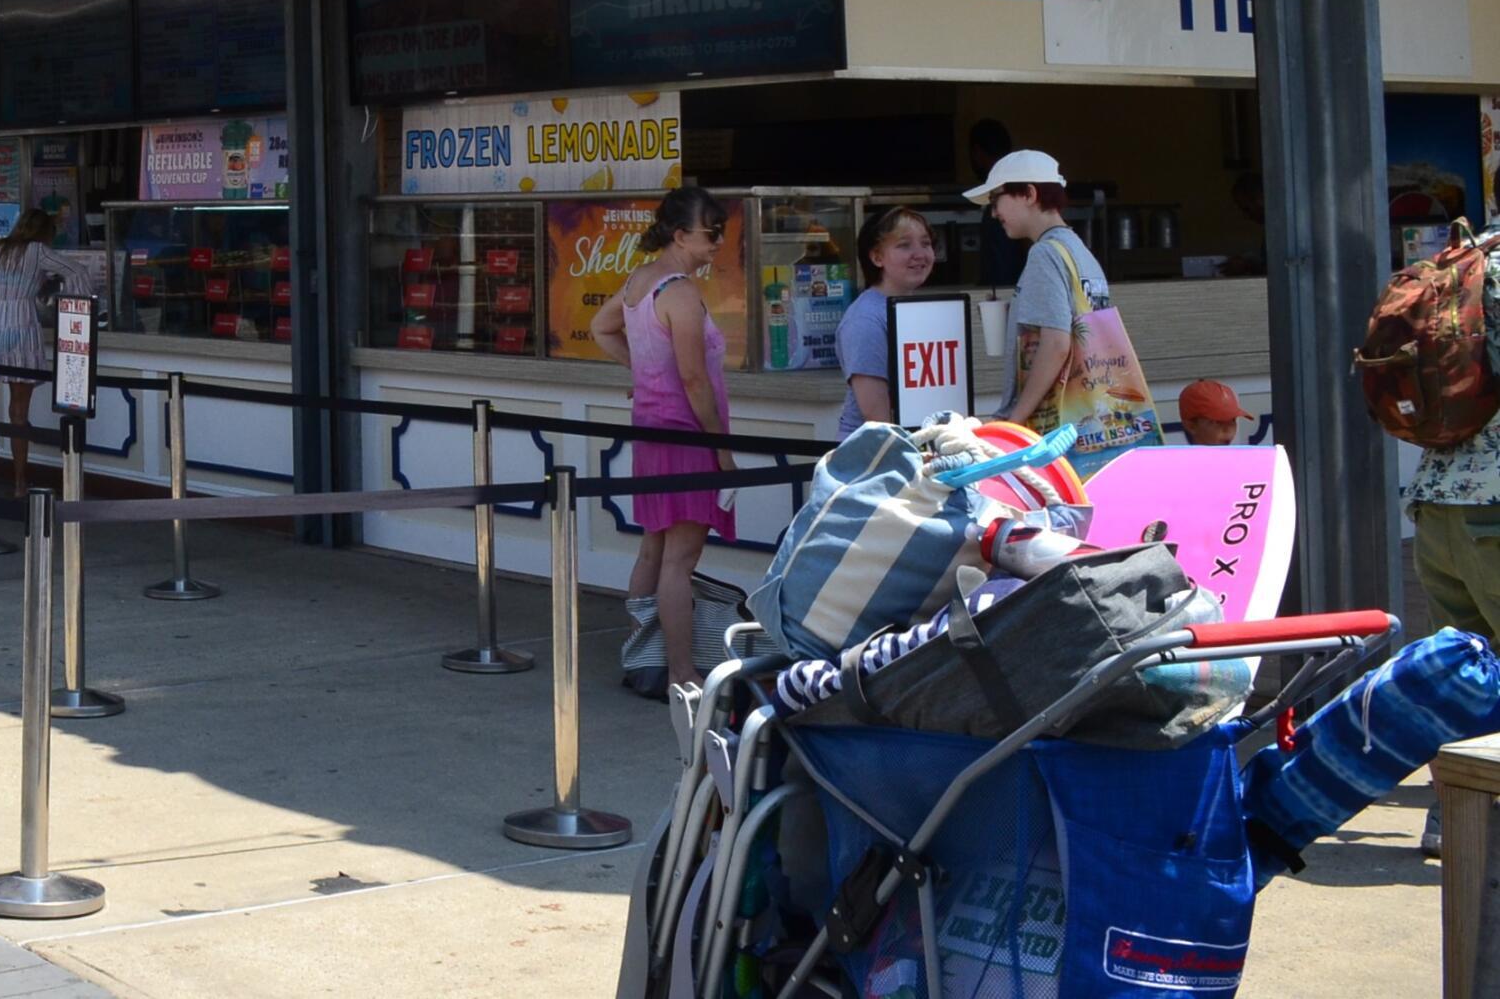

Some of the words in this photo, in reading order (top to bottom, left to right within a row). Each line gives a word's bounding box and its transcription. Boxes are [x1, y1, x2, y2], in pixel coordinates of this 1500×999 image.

[406, 124, 511, 169] FROZEN
[527, 118, 680, 163] LEMONADE
[147, 151, 213, 171] REFILLABLE
[603, 208, 659, 223] JENKINS
[569, 232, 643, 278] Shell
[582, 294, 607, 306] GET
[904, 340, 958, 388] EXIT
[1077, 417, 1153, 447] ENKINSON'S
[1223, 483, 1267, 545] PRO
[1211, 557, 1239, 577] X
